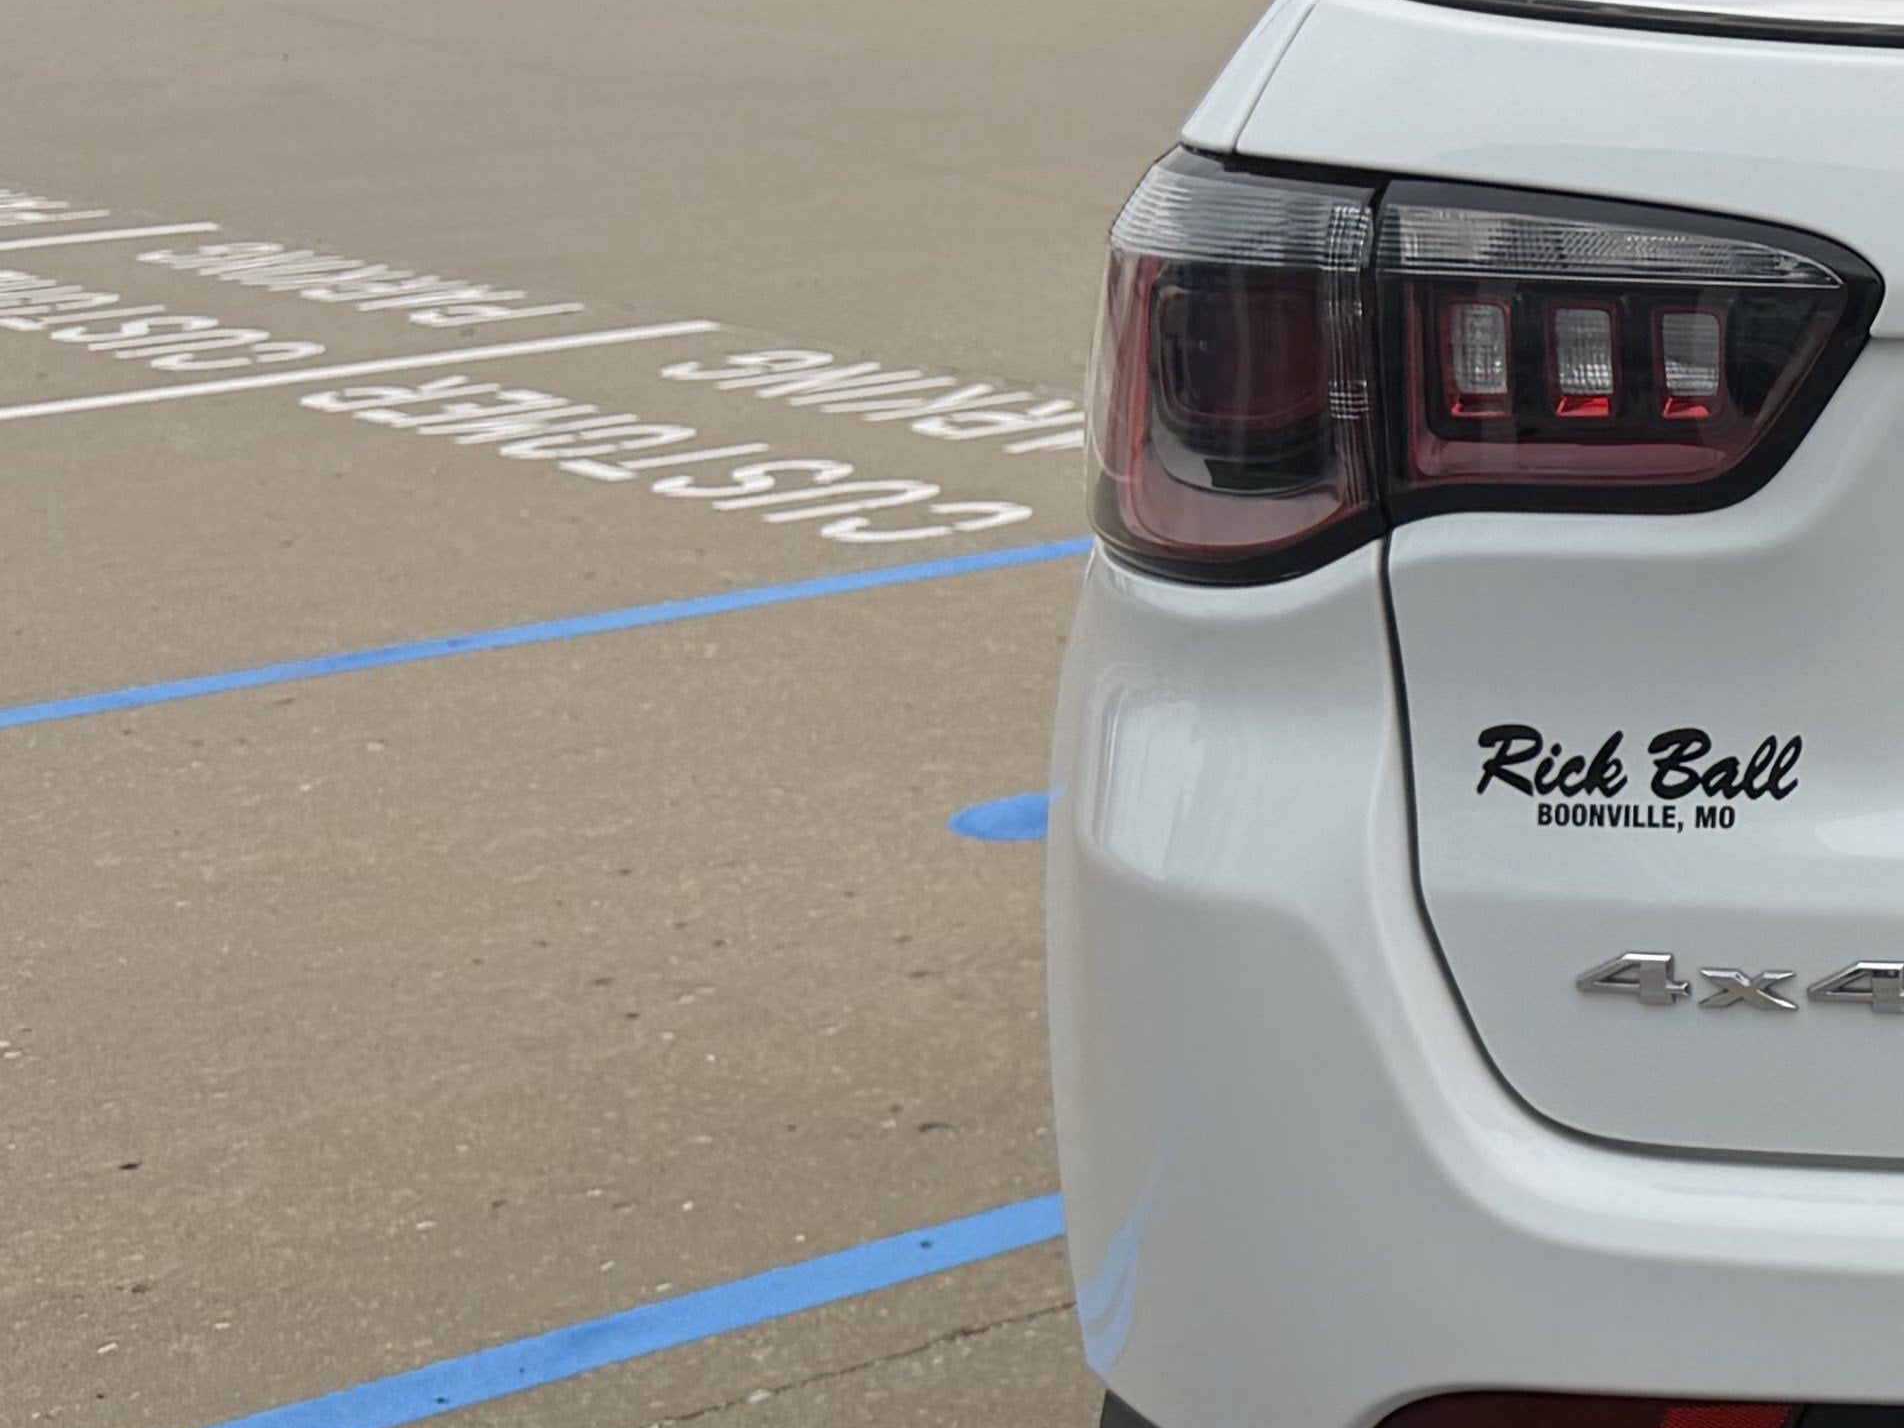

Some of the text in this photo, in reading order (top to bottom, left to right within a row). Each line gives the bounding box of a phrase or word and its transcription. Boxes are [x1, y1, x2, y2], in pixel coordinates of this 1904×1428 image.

[0, 269, 326, 371] CUSTOM
[660, 349, 1085, 454] RKING
[299, 375, 1034, 542] CUSTOMER
[1476, 723, 1803, 801] Rick Ball
[1537, 803, 1736, 833] BOONVILLE, MO
